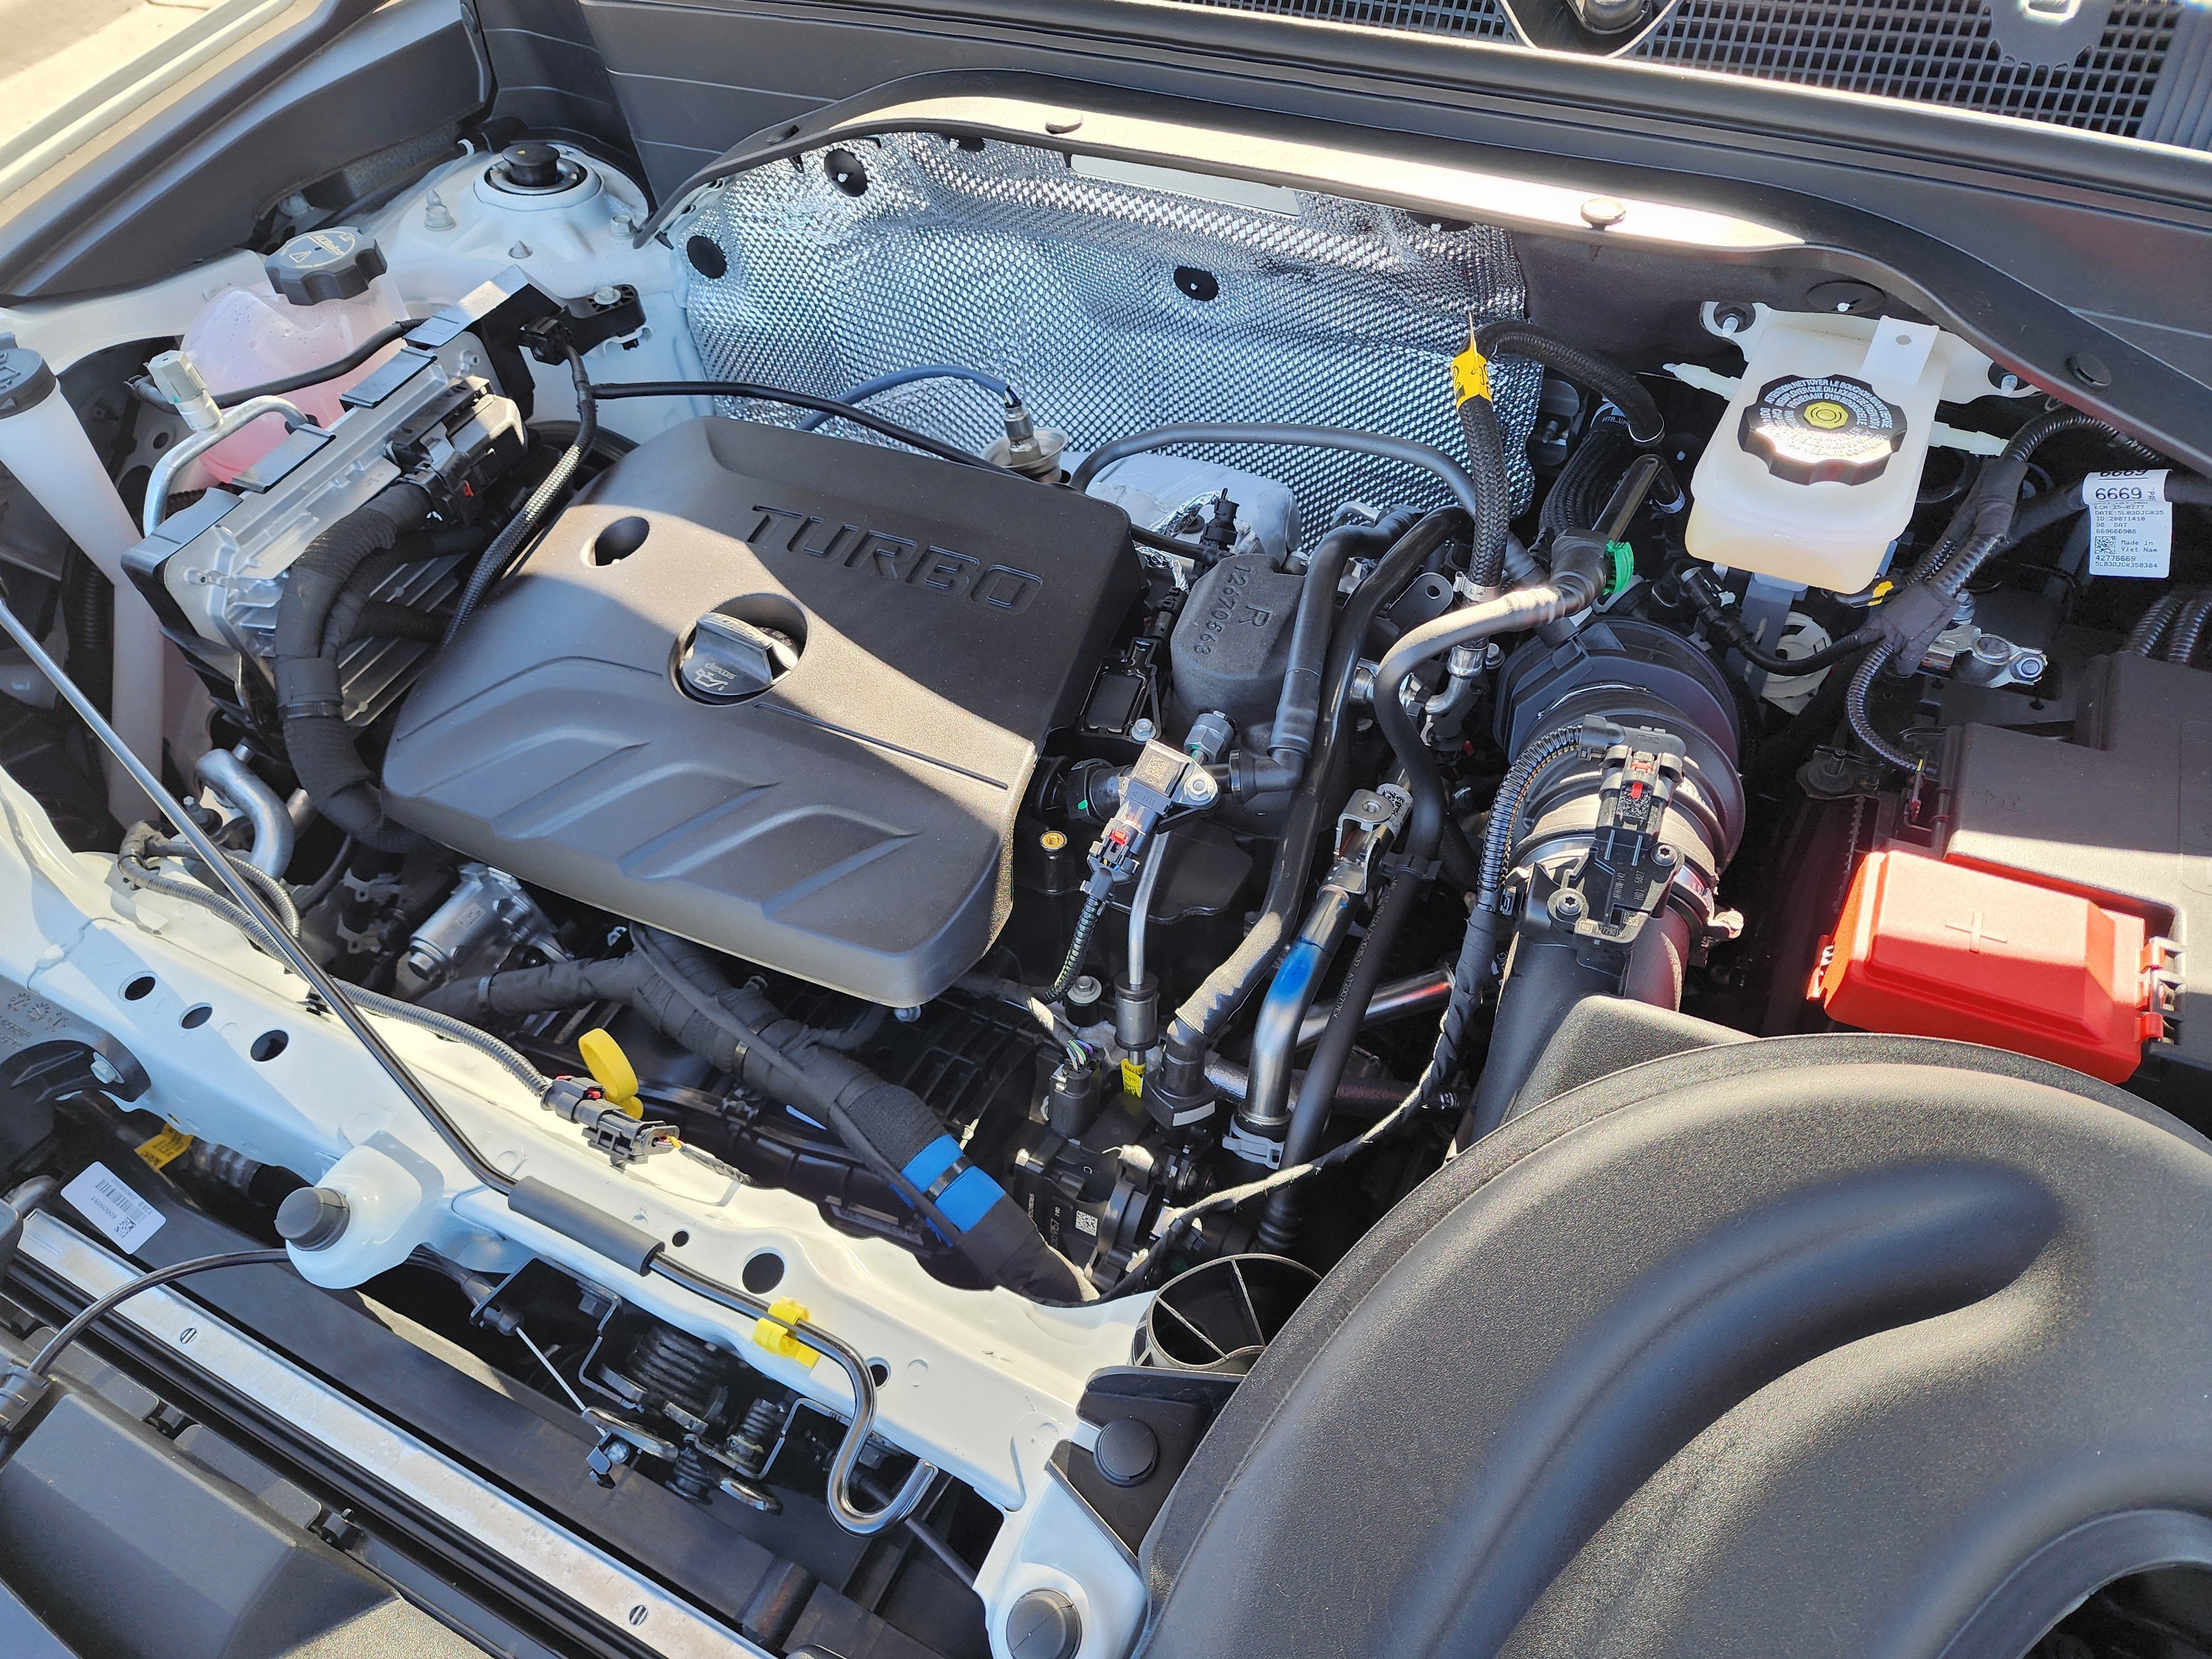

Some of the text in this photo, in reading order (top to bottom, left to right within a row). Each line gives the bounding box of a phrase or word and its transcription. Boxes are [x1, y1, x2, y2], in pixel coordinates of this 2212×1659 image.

[2095, 487, 2142, 500] 6669
[747, 504, 1044, 615] TURBO
[1239, 605, 1271, 627] R
[704, 663, 738, 680] dexos
